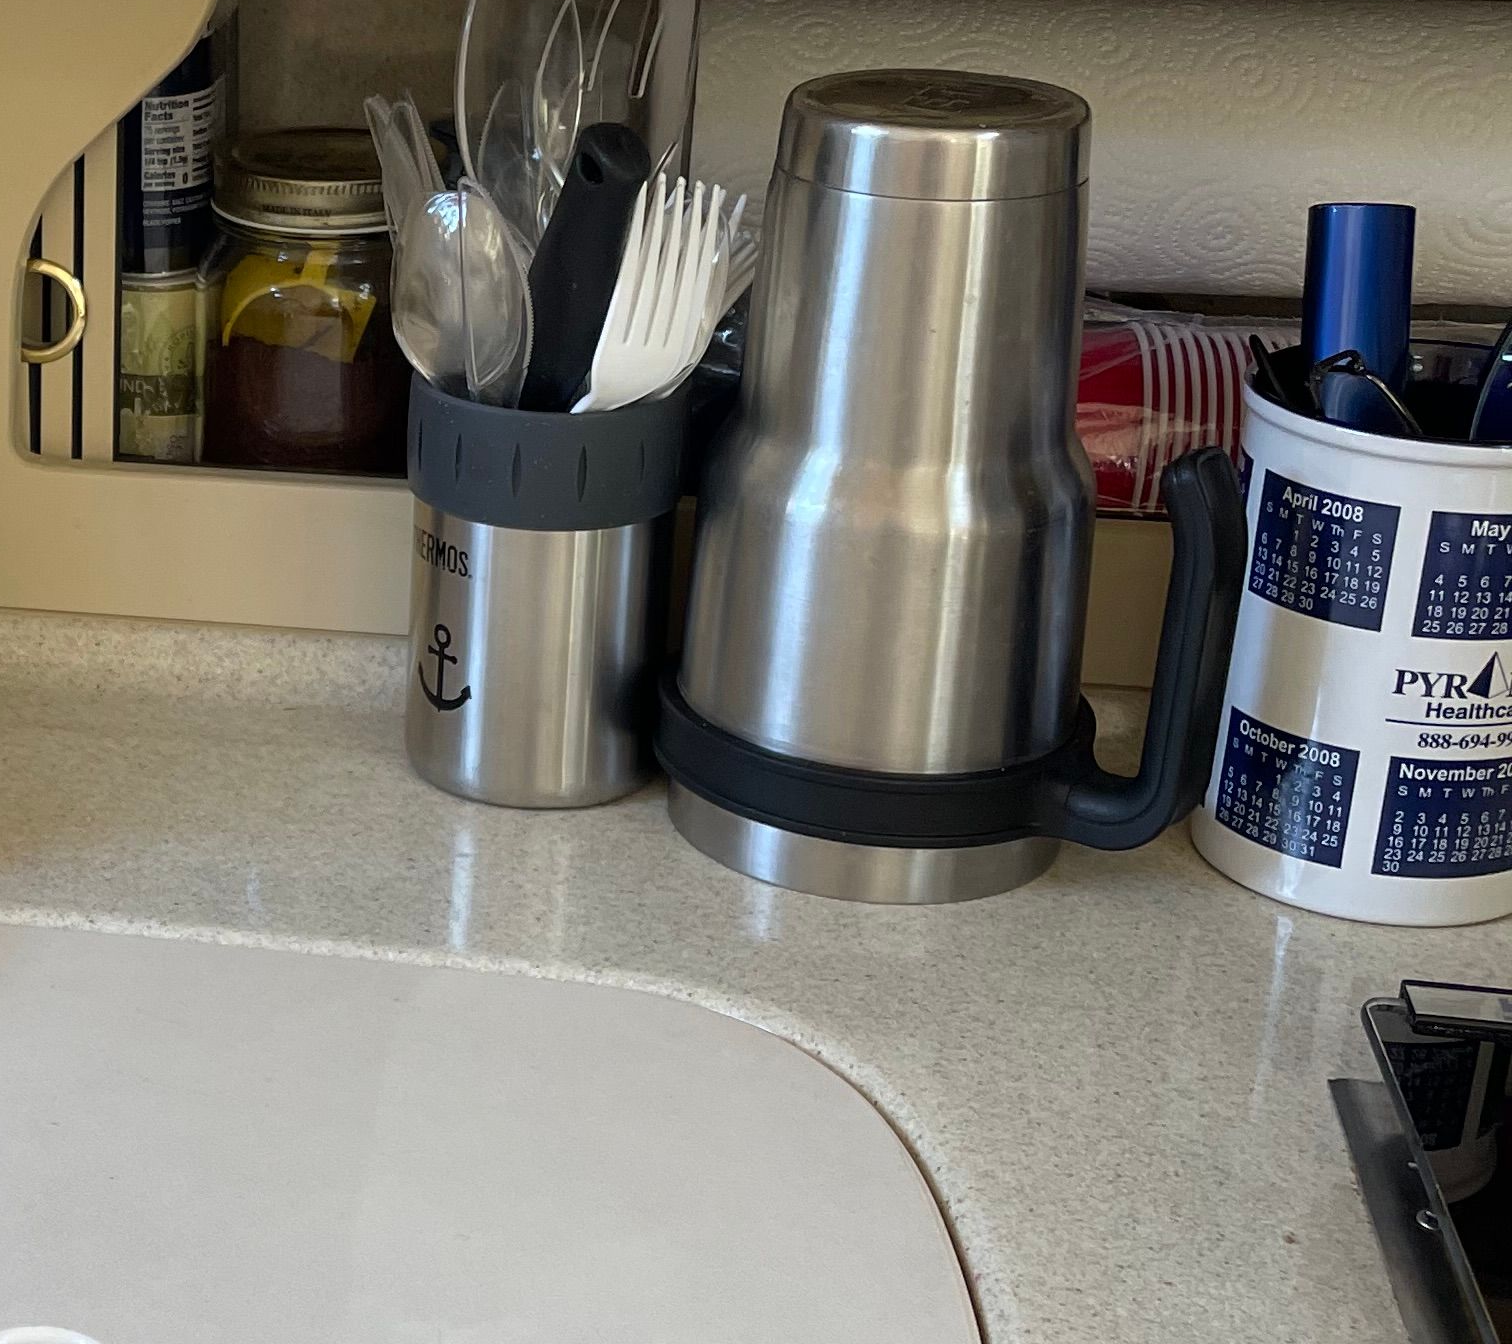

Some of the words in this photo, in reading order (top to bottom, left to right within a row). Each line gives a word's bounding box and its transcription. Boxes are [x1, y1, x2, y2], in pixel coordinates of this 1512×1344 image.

[144, 100, 189, 111] Nutrition
[144, 112, 173, 122] Facts
[1282, 486, 1319, 512] April
[1321, 498, 1364, 523] 2008
[1266, 501, 1274, 513] S
[1279, 507, 1289, 520] M
[1296, 513, 1305, 525] T
[1311, 518, 1325, 532] W
[1330, 523, 1345, 537] Th
[1353, 529, 1363, 540] F
[1371, 533, 1382, 545] S
[1471, 520, 1512, 541] May
[1261, 532, 1268, 544] 6
[1275, 538, 1282, 550] 7
[1290, 545, 1298, 557] 8
[1308, 551, 1317, 564] 9
[1326, 556, 1341, 571] 10
[1346, 561, 1360, 574] 11
[1367, 565, 1383, 579] 12
[1294, 530, 1299, 541] 1
[1310, 535, 1319, 548] 2
[1330, 541, 1340, 553] 3
[1349, 546, 1358, 558] 4
[1371, 549, 1380, 562] 5
[1439, 541, 1451, 553] S
[1461, 543, 1476, 555] M
[1487, 544, 1497, 555] T
[1258, 546, 1268, 561] 13
[1271, 553, 1283, 567] 14
[1287, 559, 1299, 573] 15
[1304, 566, 1318, 580] 16
[1324, 572, 1339, 585] 17
[1343, 576, 1359, 590] 18
[1365, 580, 1381, 594] 19
[1254, 560, 1266, 576] 20
[1268, 567, 1279, 582] 21
[1282, 574, 1297, 589] 22
[1300, 580, 1316, 595] 23
[1319, 586, 1337, 600] 24
[1339, 591, 1357, 605] 25
[1359, 596, 1378, 609] 26
[1434, 574, 1444, 587] 4
[1457, 575, 1468, 588] 5
[1480, 575, 1490, 588] 6
[1504, 575, 1512, 588] 7
[1252, 576, 1264, 590] 27
[1265, 582, 1278, 598] 28
[1280, 589, 1295, 604] 29
[1298, 595, 1314, 611] 30
[1429, 589, 1445, 601] 11
[1453, 591, 1470, 604] 12
[1476, 591, 1492, 604] 13
[1498, 592, 1512, 603] 14
[1427, 605, 1443, 618] 18
[1450, 606, 1467, 619] 19
[1471, 607, 1489, 620] 20
[1493, 607, 1510, 620] 21
[1421, 620, 1441, 633] 25
[1446, 621, 1464, 634] 26
[1468, 622, 1487, 635] 27
[1490, 622, 1508, 635] 28
[1239, 719, 1296, 755] October
[1297, 743, 1341, 768] 2008
[1399, 763, 1495, 782] November
